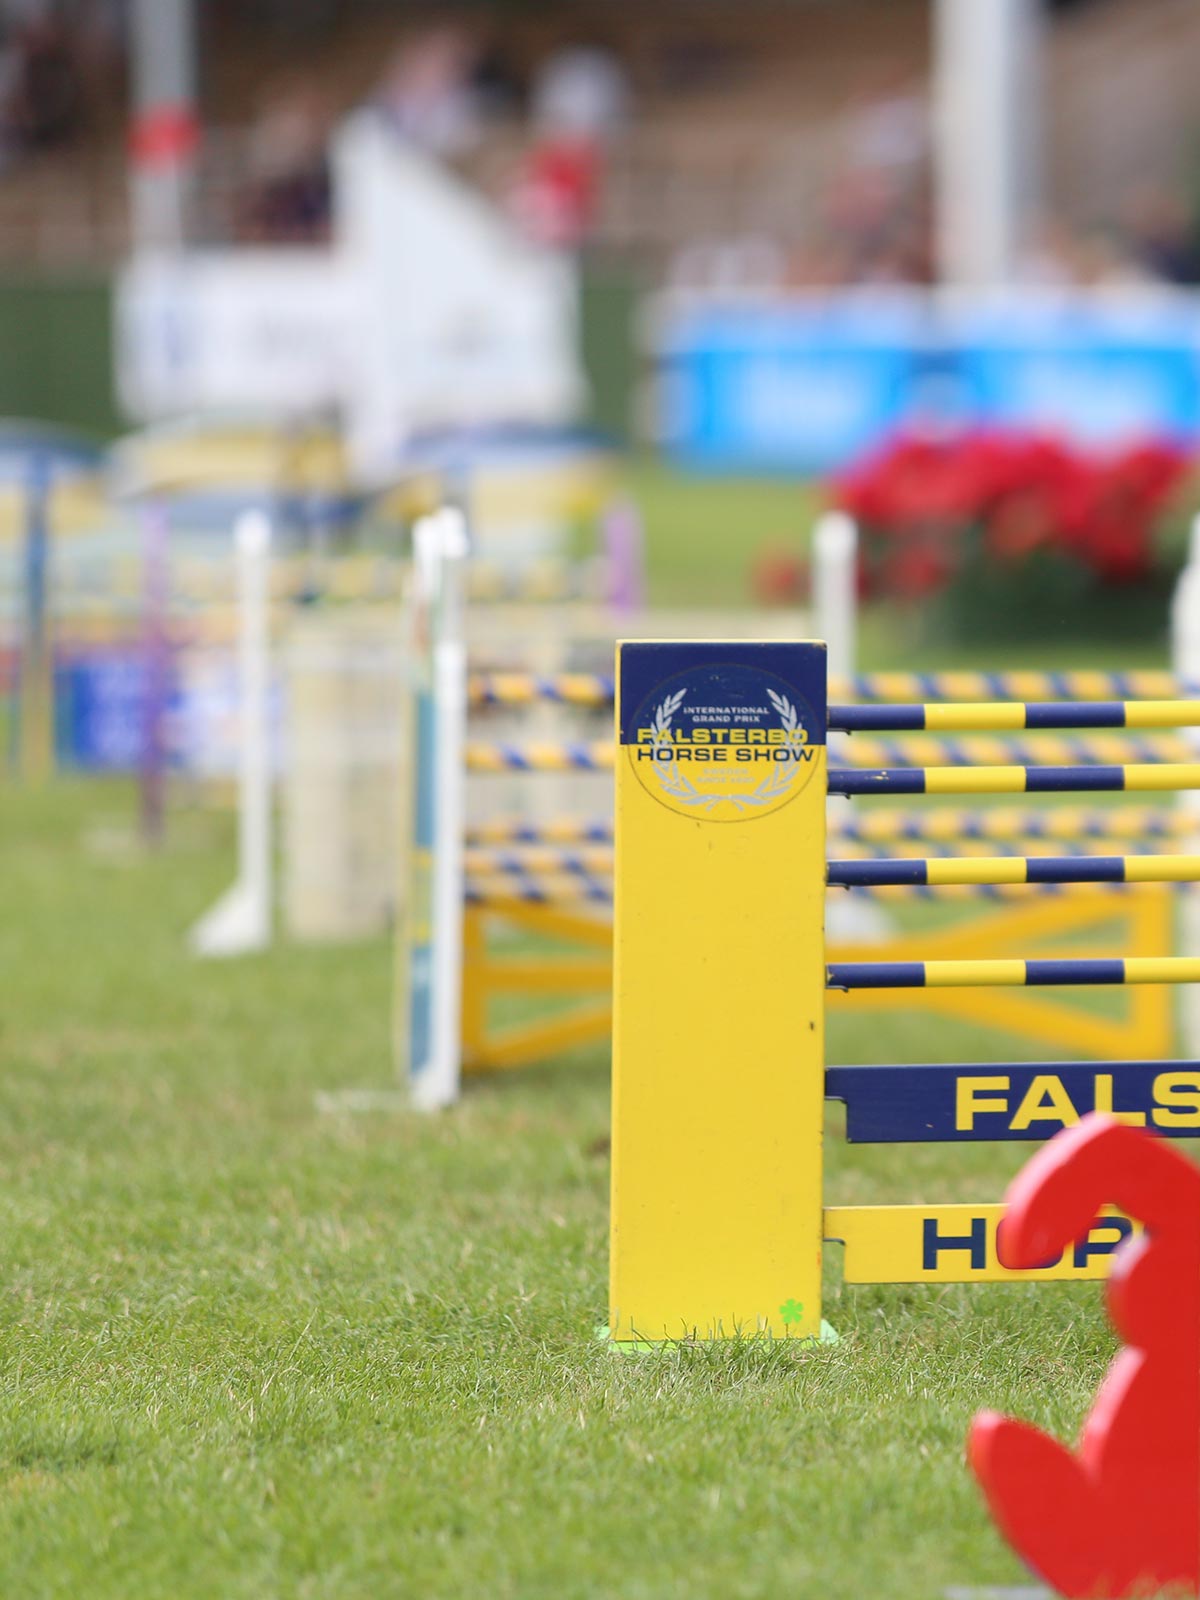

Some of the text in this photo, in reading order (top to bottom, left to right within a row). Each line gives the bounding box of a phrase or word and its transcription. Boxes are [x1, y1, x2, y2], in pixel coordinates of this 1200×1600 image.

[683, 706, 770, 714] INTERNATIONAL
[692, 715, 760, 723] GRAND PRIX
[637, 728, 808, 744] FALSTERBO
[637, 748, 814, 761] HORSE SHOW
